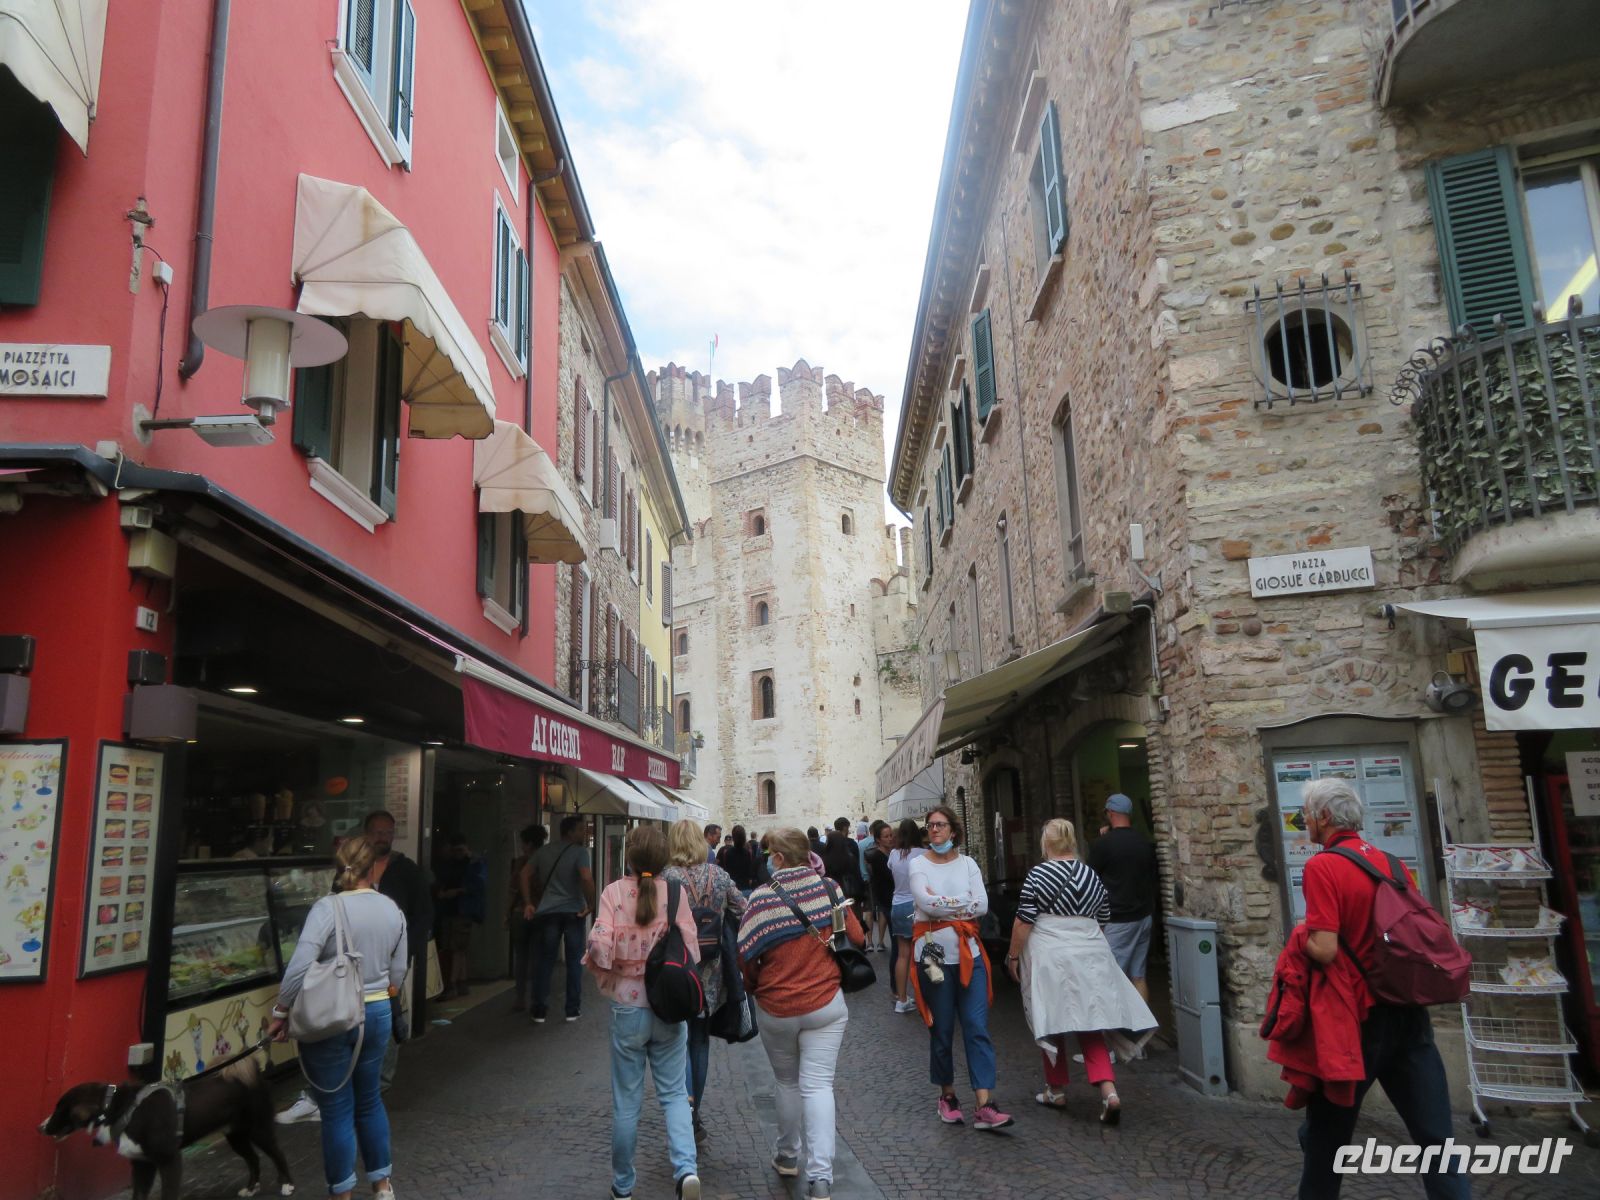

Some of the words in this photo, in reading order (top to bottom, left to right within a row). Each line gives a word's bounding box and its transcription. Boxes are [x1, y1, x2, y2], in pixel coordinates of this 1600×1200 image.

[4, 351, 70, 365] PIAZZETTA
[0, 369, 76, 387] MOSAICI
[1292, 558, 1327, 570] PIAZZA
[1255, 574, 1304, 590] GIOSUE
[1308, 567, 1370, 585] CARDUCCI
[1489, 652, 1600, 711] GE
[531, 714, 548, 753] AI
[549, 720, 581, 760] CIGNI
[611, 743, 626, 772] BAR
[647, 756, 668, 781] PIZZERIA
